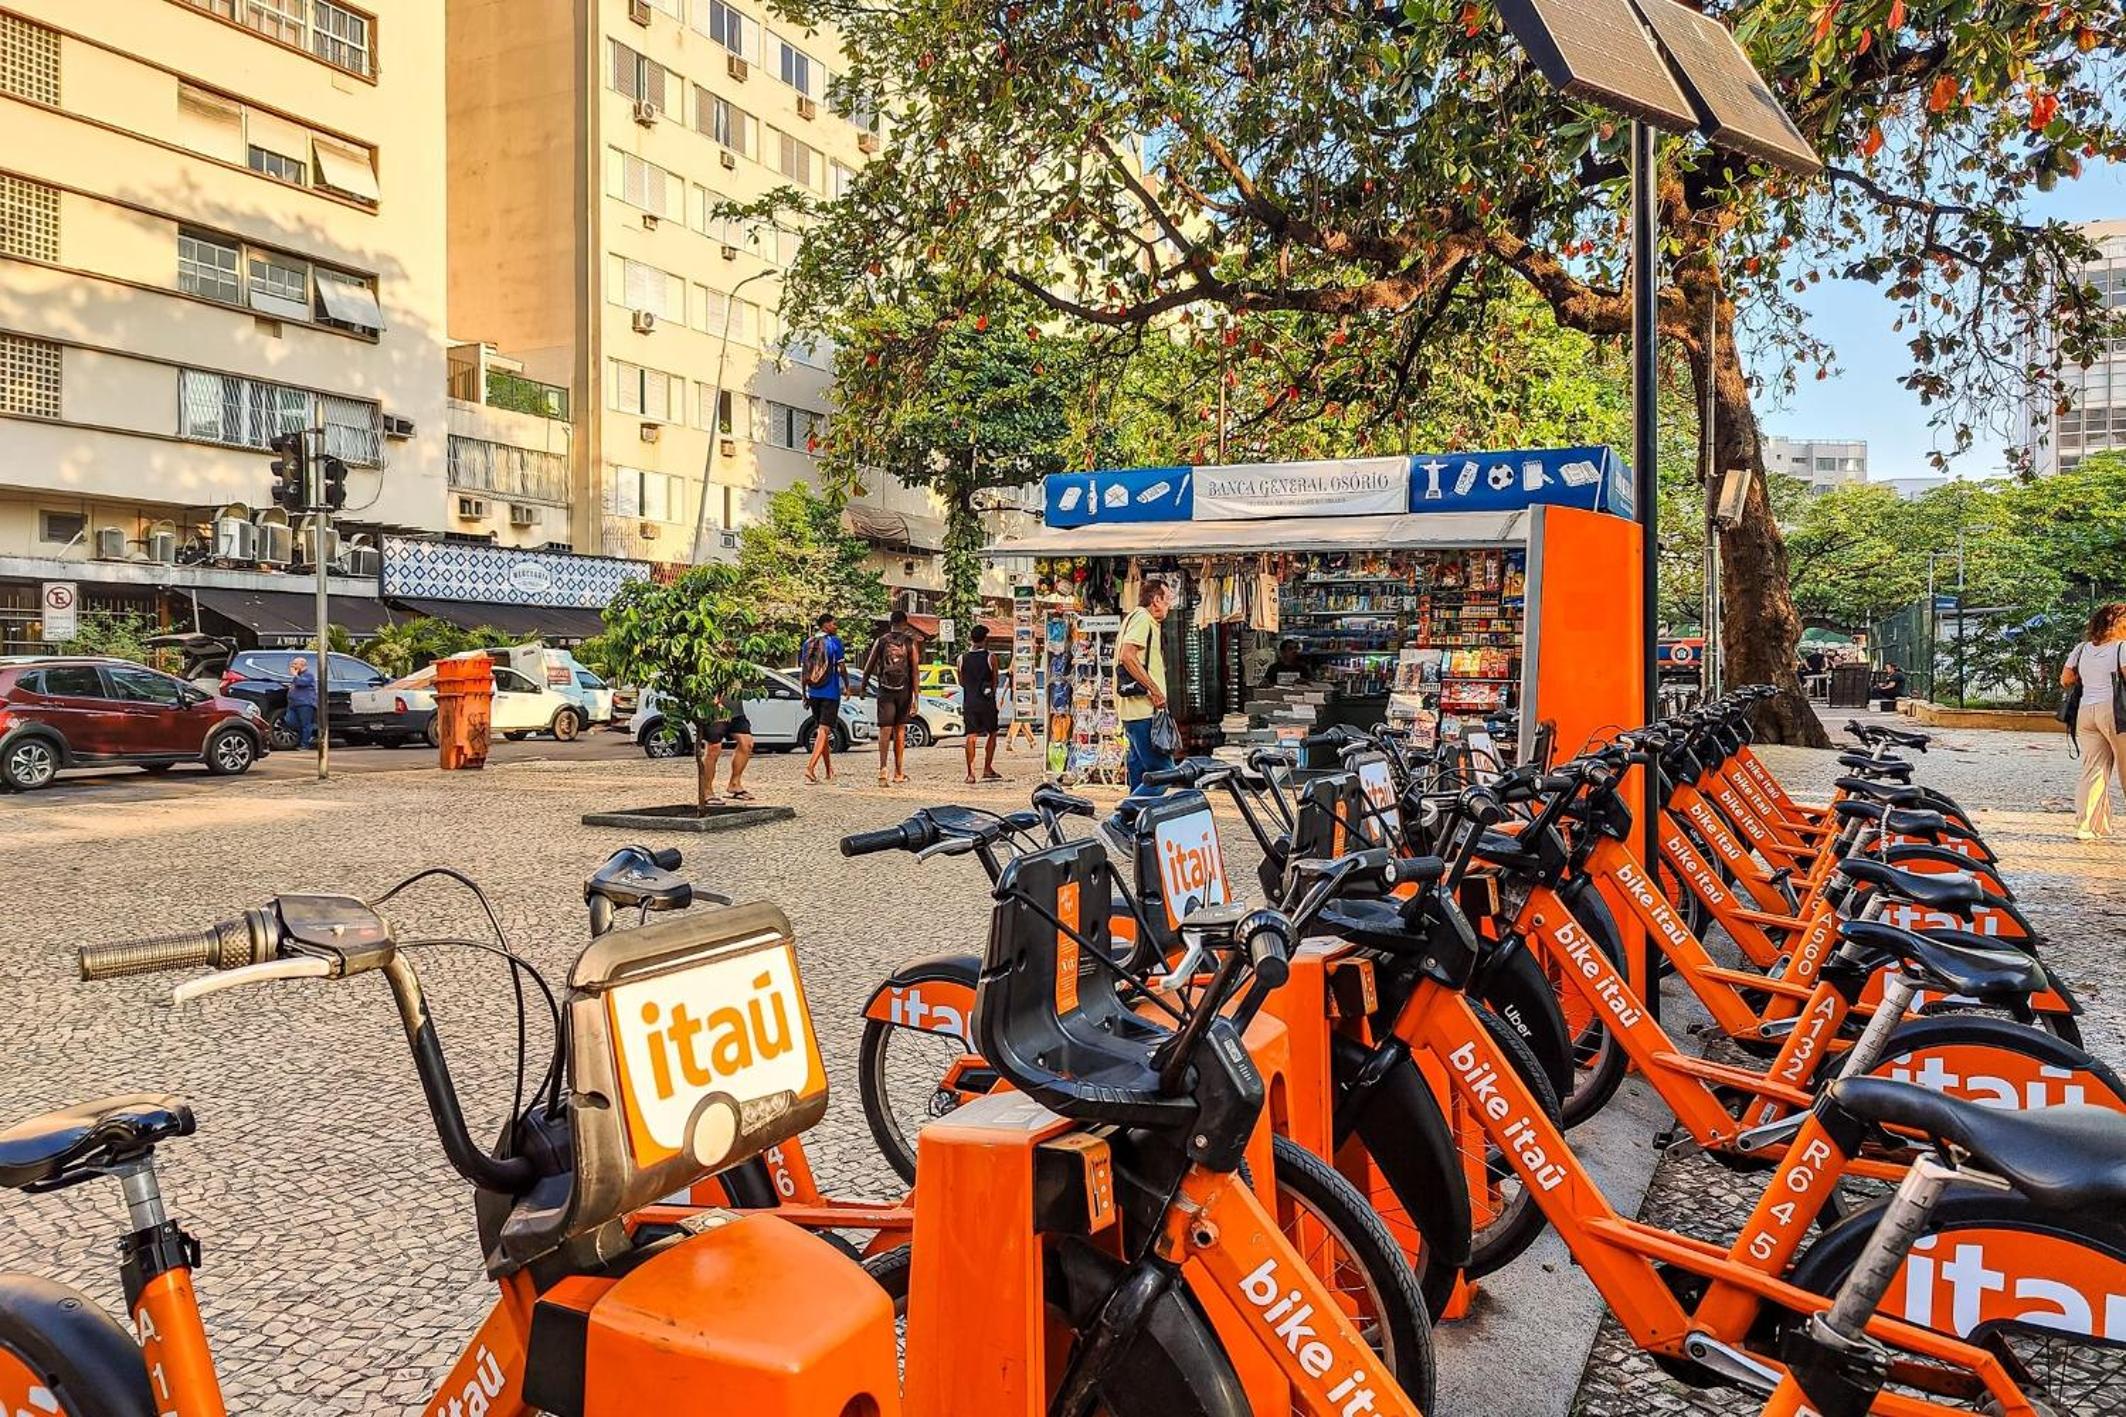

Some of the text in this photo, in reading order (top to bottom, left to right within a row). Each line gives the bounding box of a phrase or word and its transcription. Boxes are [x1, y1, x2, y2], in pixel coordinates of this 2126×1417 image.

[1208, 471, 1389, 497] BANCA GENERAL OSÓRIO
[1732, 772, 1772, 815] bike itaú
[1745, 759, 1780, 799] bike itaú
[1690, 803, 1742, 860] bike itaú
[1720, 790, 1765, 840] bike itaú
[1165, 831, 1217, 897] itaú
[1666, 836, 1725, 904] bike itaú
[1616, 863, 1688, 946] bike itaú
[1879, 905, 1998, 936] taú
[1553, 921, 1642, 1028] bike itaú
[641, 970, 793, 1100] itaú
[891, 986, 978, 1054] ita
[1504, 1004, 1532, 1038] Uber
[1781, 996, 1835, 1081] A132
[1449, 1040, 1568, 1191] bike itaú
[1749, 1138, 1831, 1260] R645
[136, 1308, 178, 1417] A1
[1238, 1258, 1383, 1417] bike it
[438, 1343, 506, 1417] taú
